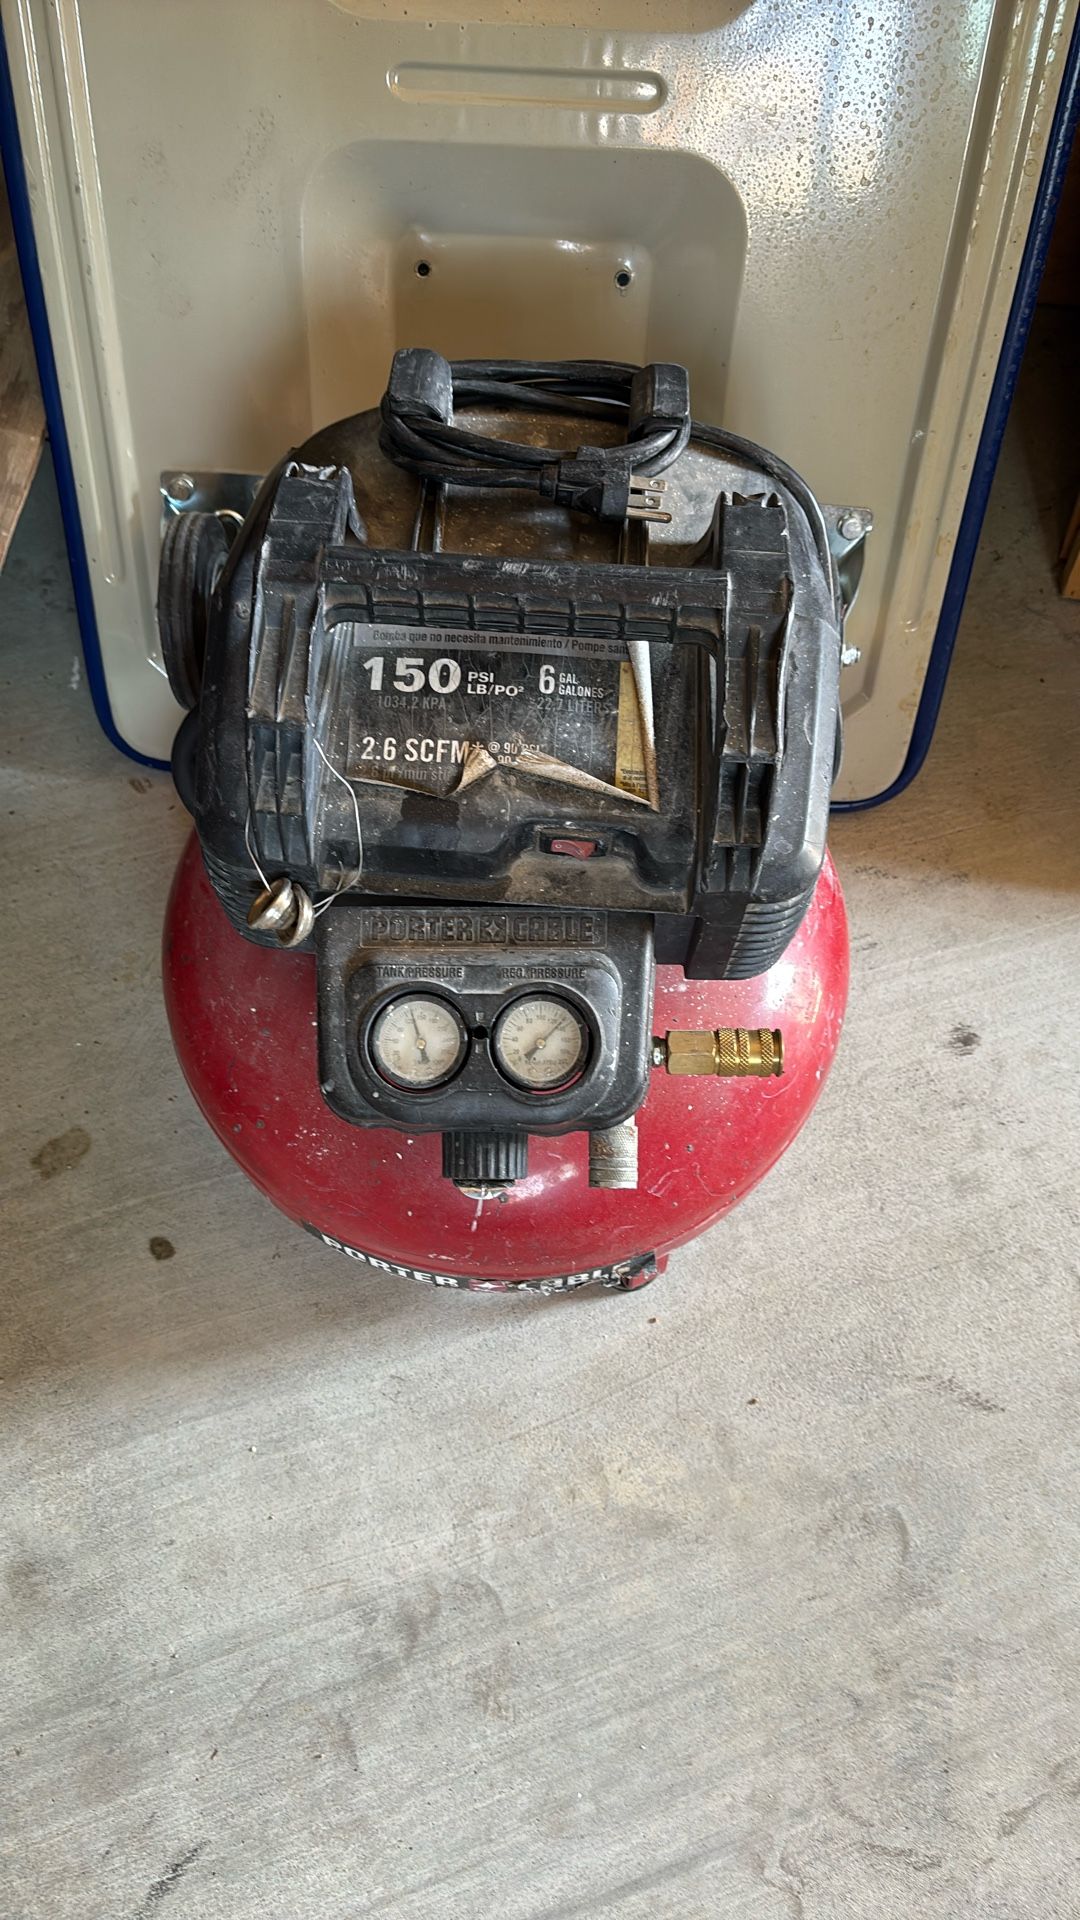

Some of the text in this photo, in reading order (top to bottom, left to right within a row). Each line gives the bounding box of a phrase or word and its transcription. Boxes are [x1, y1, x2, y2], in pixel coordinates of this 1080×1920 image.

[409, 632, 428, 644] que
[430, 633, 442, 643] no
[445, 633, 487, 646] necesita
[488, 636, 563, 650] mantenimiento
[572, 640, 606, 655] Pompe
[363, 656, 461, 694] 150
[467, 671, 494, 683] PSI
[538, 664, 555, 694] 6
[467, 683, 524, 697] LB/PO²
[558, 684, 604, 699] GALONES
[378, 695, 446, 711] 1034.2 KPA
[361, 736, 397, 761] 2.6
[488, 741, 500, 753] @
[503, 742, 518, 754] 90
[371, 916, 594, 942] PORTER CABLE
[377, 966, 463, 979] TANK PRESSURE
[530, 968, 586, 979] PRESSURE
[321, 1233, 459, 1288] PORTER
